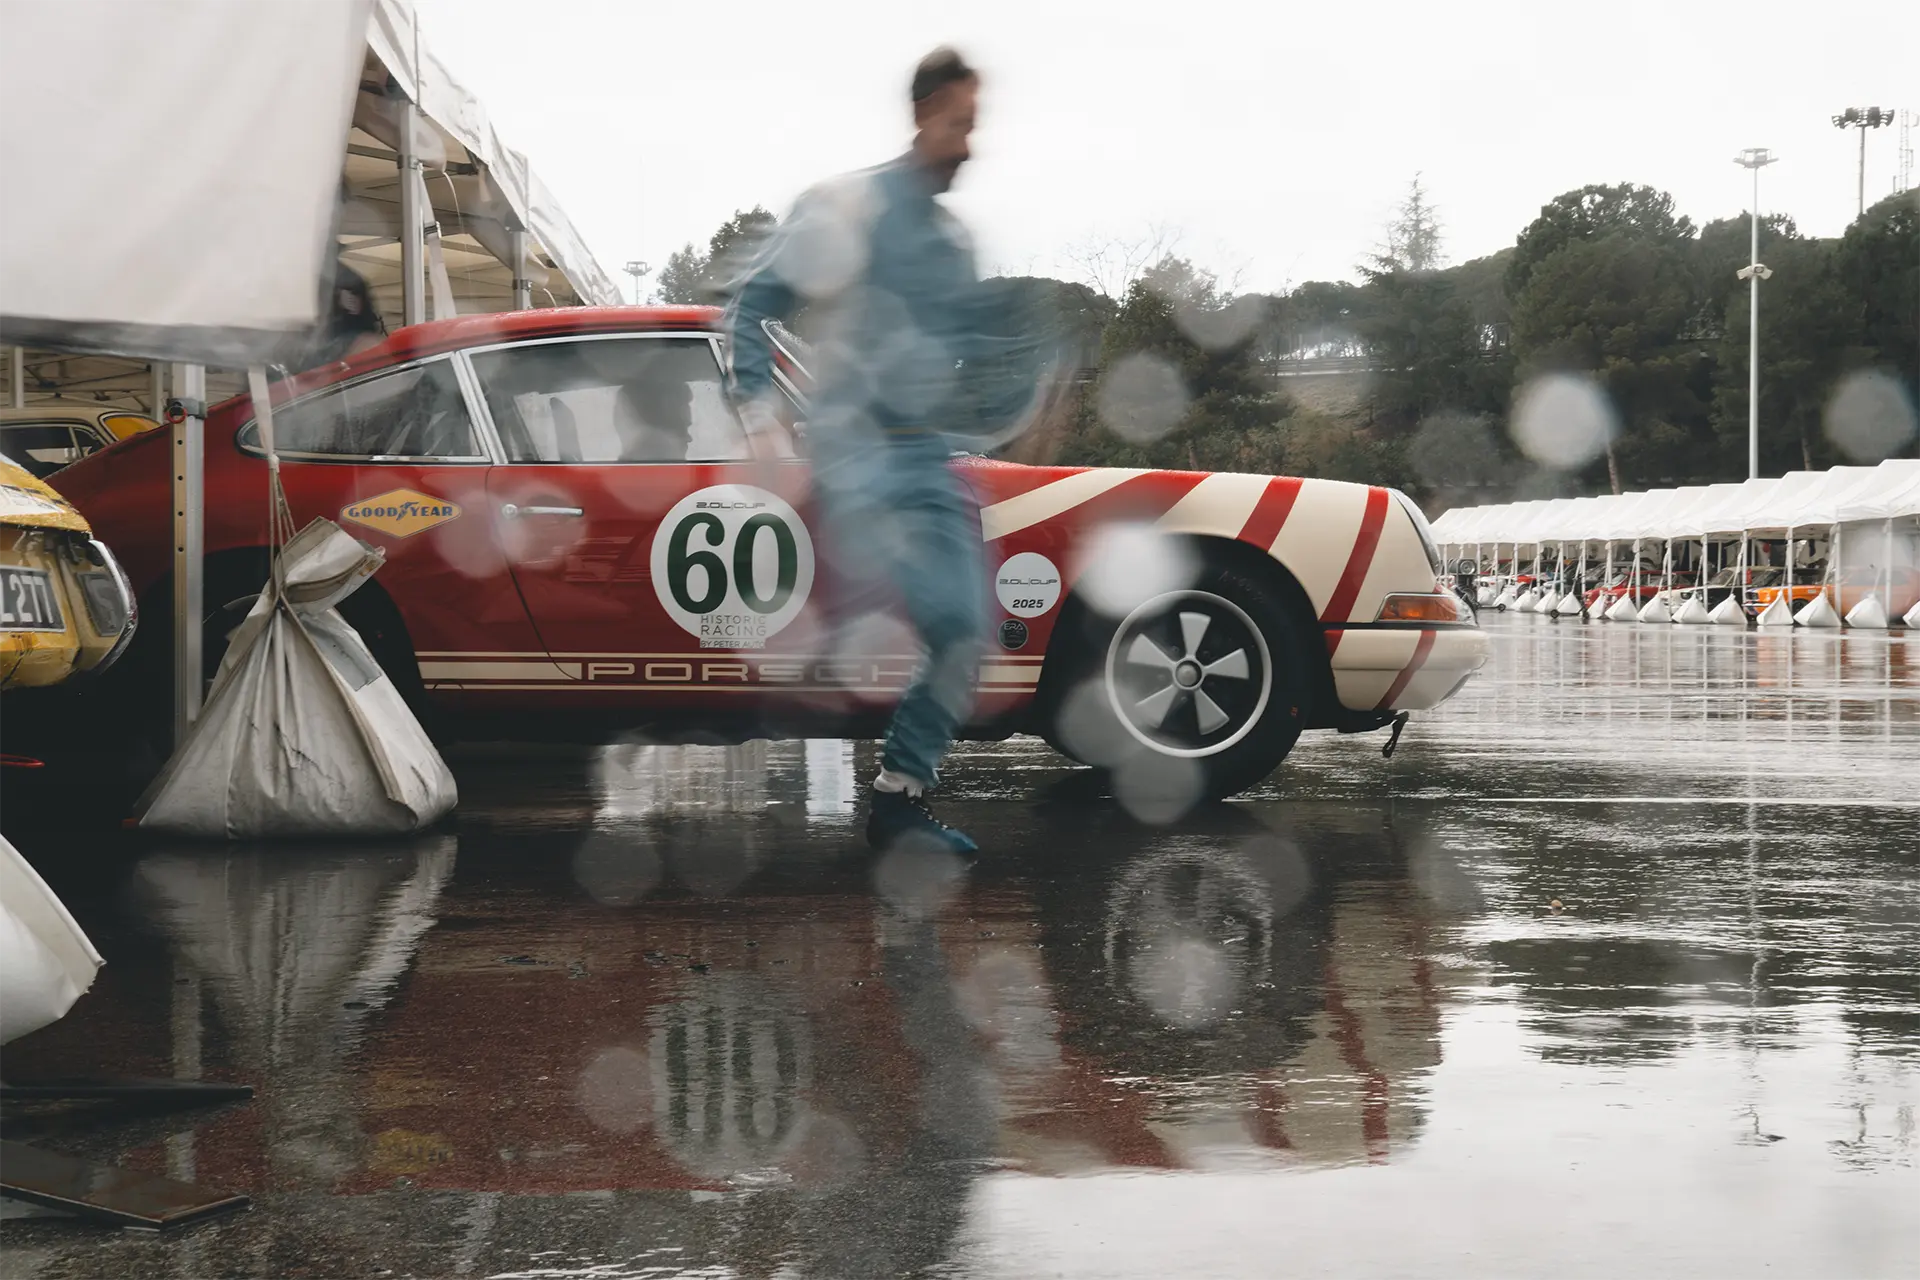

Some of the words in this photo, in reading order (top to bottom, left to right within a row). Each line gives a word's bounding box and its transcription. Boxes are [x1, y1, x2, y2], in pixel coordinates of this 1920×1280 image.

[667, 512, 798, 614] 60
[1012, 599, 1044, 609] 2025
[700, 614, 767, 625] HISTORIC
[700, 624, 767, 636] RACING
[700, 640, 712, 648] BY
[714, 640, 740, 648] PETER
[588, 662, 919, 682] PORSCH
